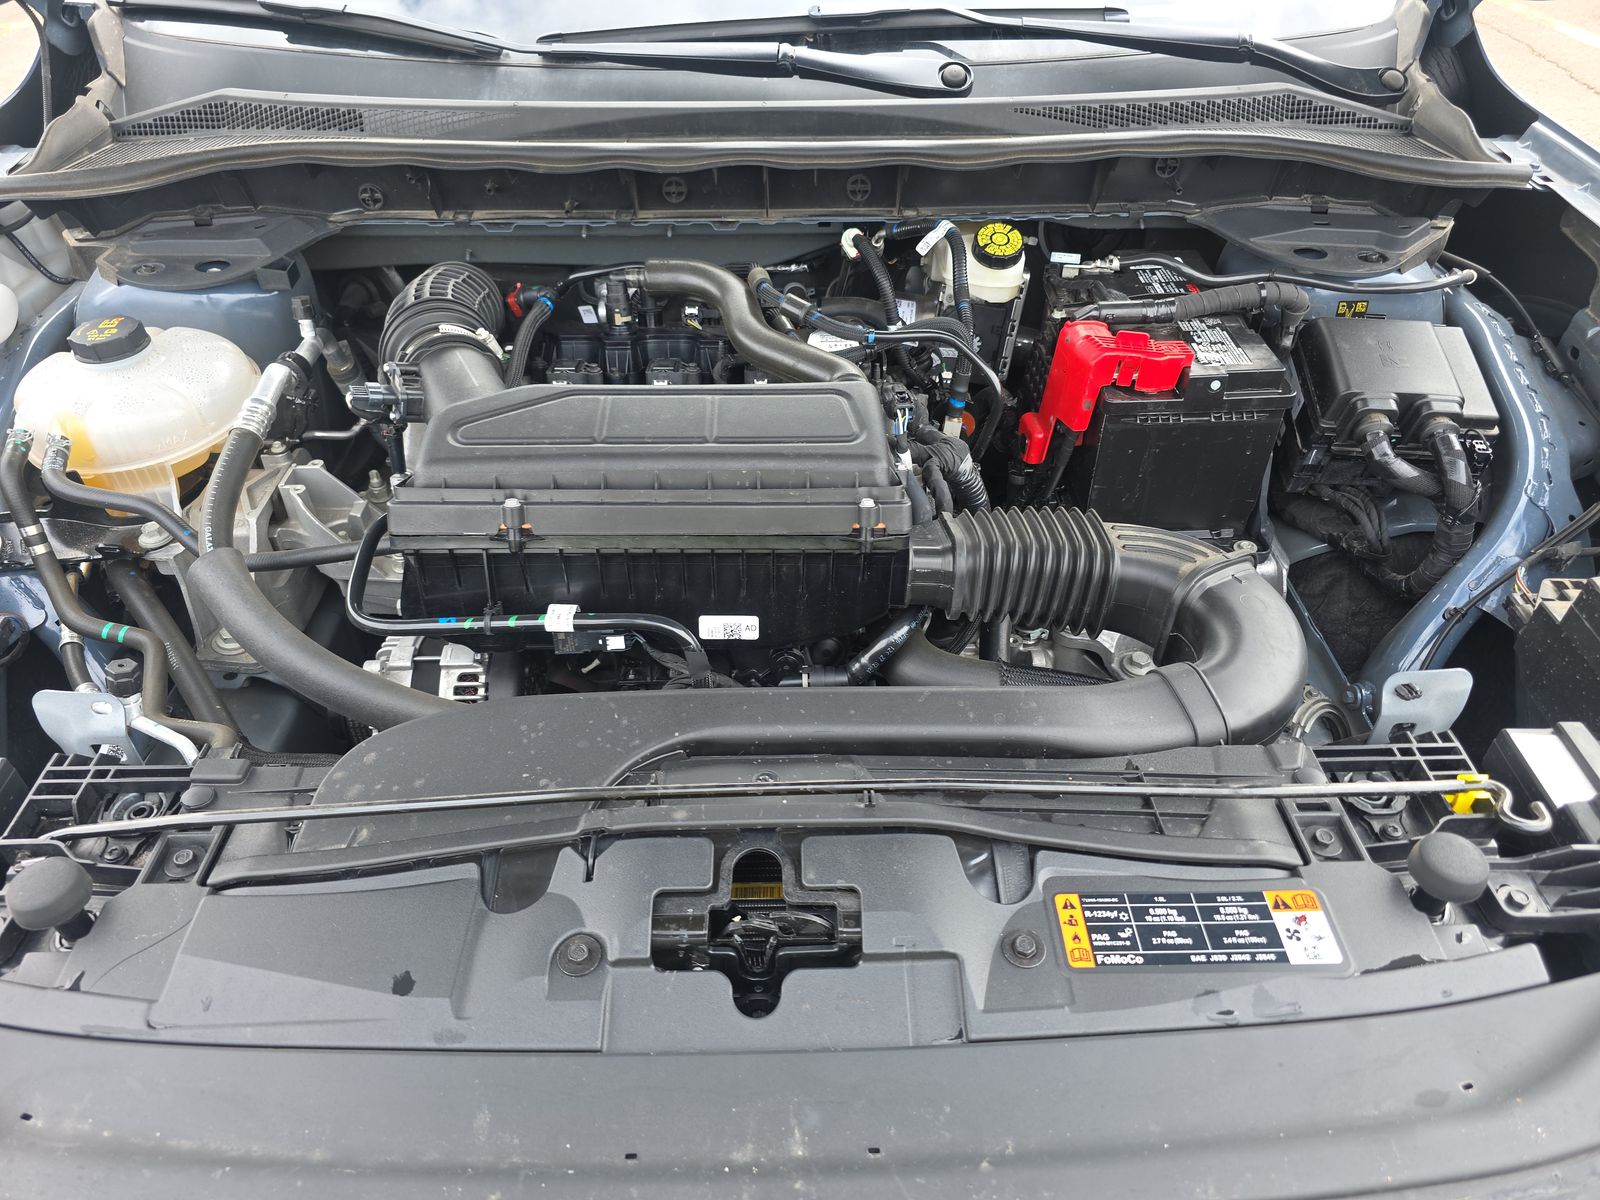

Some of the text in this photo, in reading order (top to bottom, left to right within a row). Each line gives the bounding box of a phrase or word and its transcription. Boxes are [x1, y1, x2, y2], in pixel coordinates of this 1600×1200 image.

[744, 624, 757, 632] AD
[1084, 910, 1118, 919] R-1234yf
[1091, 933, 1110, 941] PAG
[1234, 929, 1250, 937] PAG
[1096, 954, 1145, 965] FoMoCo
